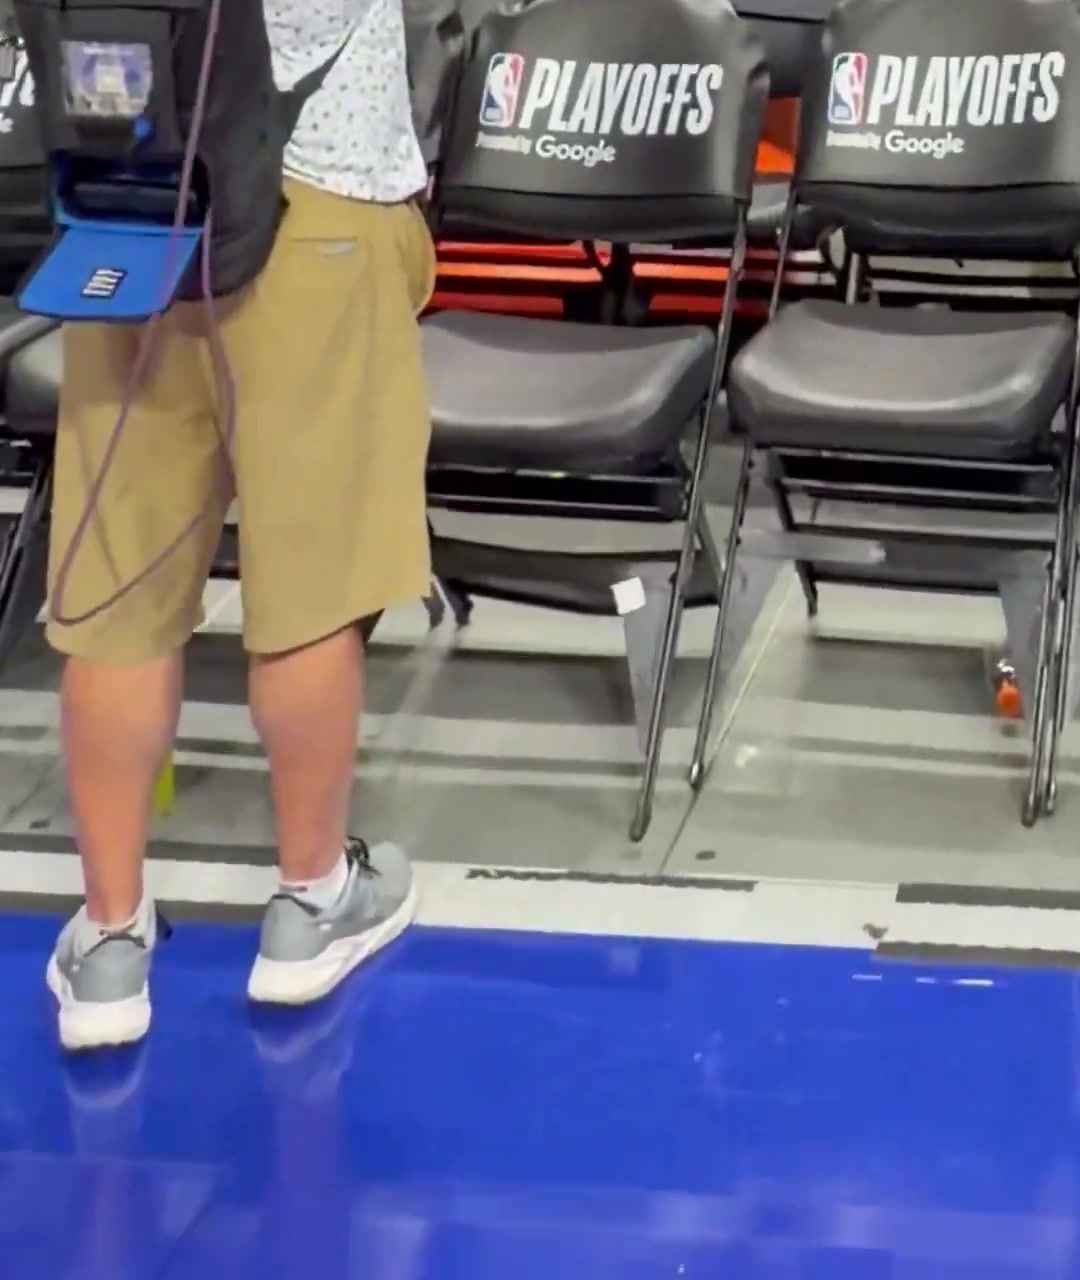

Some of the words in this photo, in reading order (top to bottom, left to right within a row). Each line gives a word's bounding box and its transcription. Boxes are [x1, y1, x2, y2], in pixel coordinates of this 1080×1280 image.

[518, 57, 723, 137] PLAYOFFS
[867, 51, 1066, 127] PLAYOFFS
[535, 134, 616, 167] Google
[885, 129, 965, 160] Google
